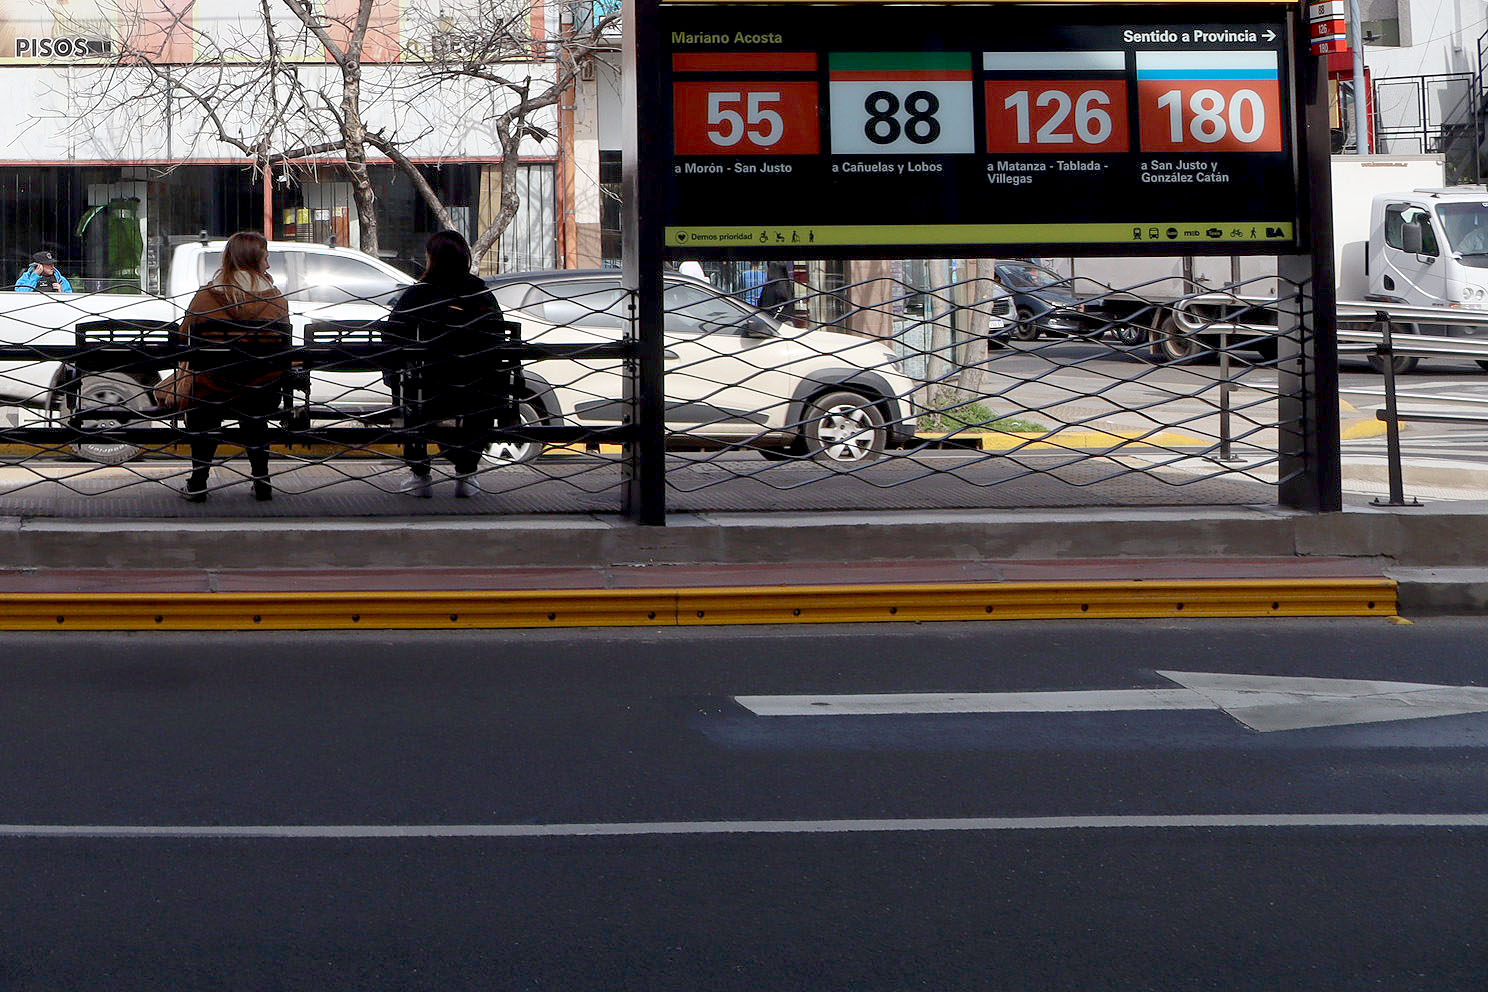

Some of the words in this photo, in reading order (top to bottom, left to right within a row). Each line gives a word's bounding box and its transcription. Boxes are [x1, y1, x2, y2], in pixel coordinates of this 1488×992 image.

[671, 31, 730, 44] Mariano
[733, 31, 783, 44] Acosta
[1123, 30, 1178, 43] Sentido
[1181, 33, 1190, 43] a
[1193, 30, 1257, 43] Provincia
[15, 37, 88, 57] PISOS
[706, 91, 784, 147] 55
[864, 90, 941, 145] 88
[1004, 89, 1112, 144] 126
[1157, 88, 1266, 144] 180
[674, 164, 682, 174] a
[684, 162, 724, 174] Morón
[734, 162, 757, 173] San
[760, 162, 792, 173] Justo
[832, 164, 839, 173] a
[842, 161, 894, 172] Cañuelas
[897, 164, 904, 174] y
[907, 161, 943, 172] Lobos
[987, 163, 994, 172] a
[997, 160, 1046, 171] Matanza
[1056, 160, 1101, 171] Tablada
[1141, 162, 1148, 170] a
[1151, 159, 1173, 170] San
[1175, 159, 1208, 170] Justo
[1210, 162, 1218, 172] y
[987, 173, 1033, 186] Villegas
[1141, 171, 1193, 183] González
[1196, 171, 1230, 183] Catán
[691, 233, 718, 241] Demos
[719, 233, 753, 243] prioridad
